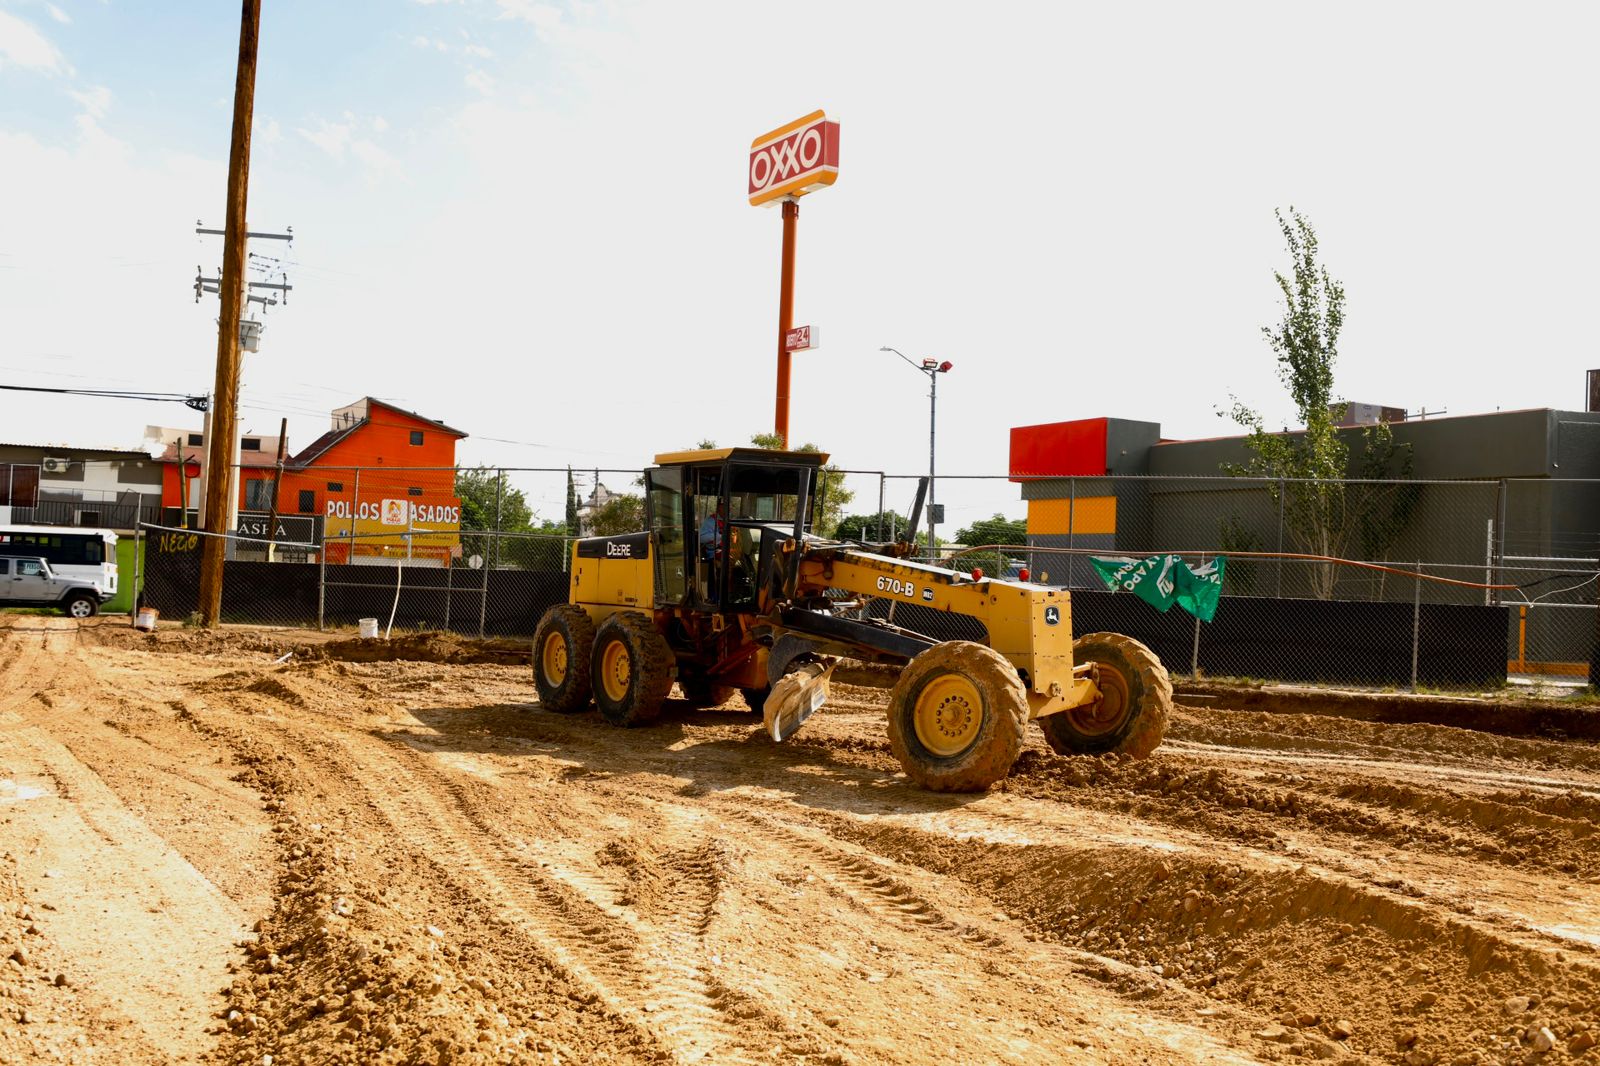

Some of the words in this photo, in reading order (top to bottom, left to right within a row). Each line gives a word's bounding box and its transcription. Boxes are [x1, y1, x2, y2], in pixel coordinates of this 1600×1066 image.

[751, 127, 822, 190] OXXO
[410, 503, 459, 524] ASADOS
[606, 541, 632, 556] DEERE
[877, 576, 914, 597] 670-B
